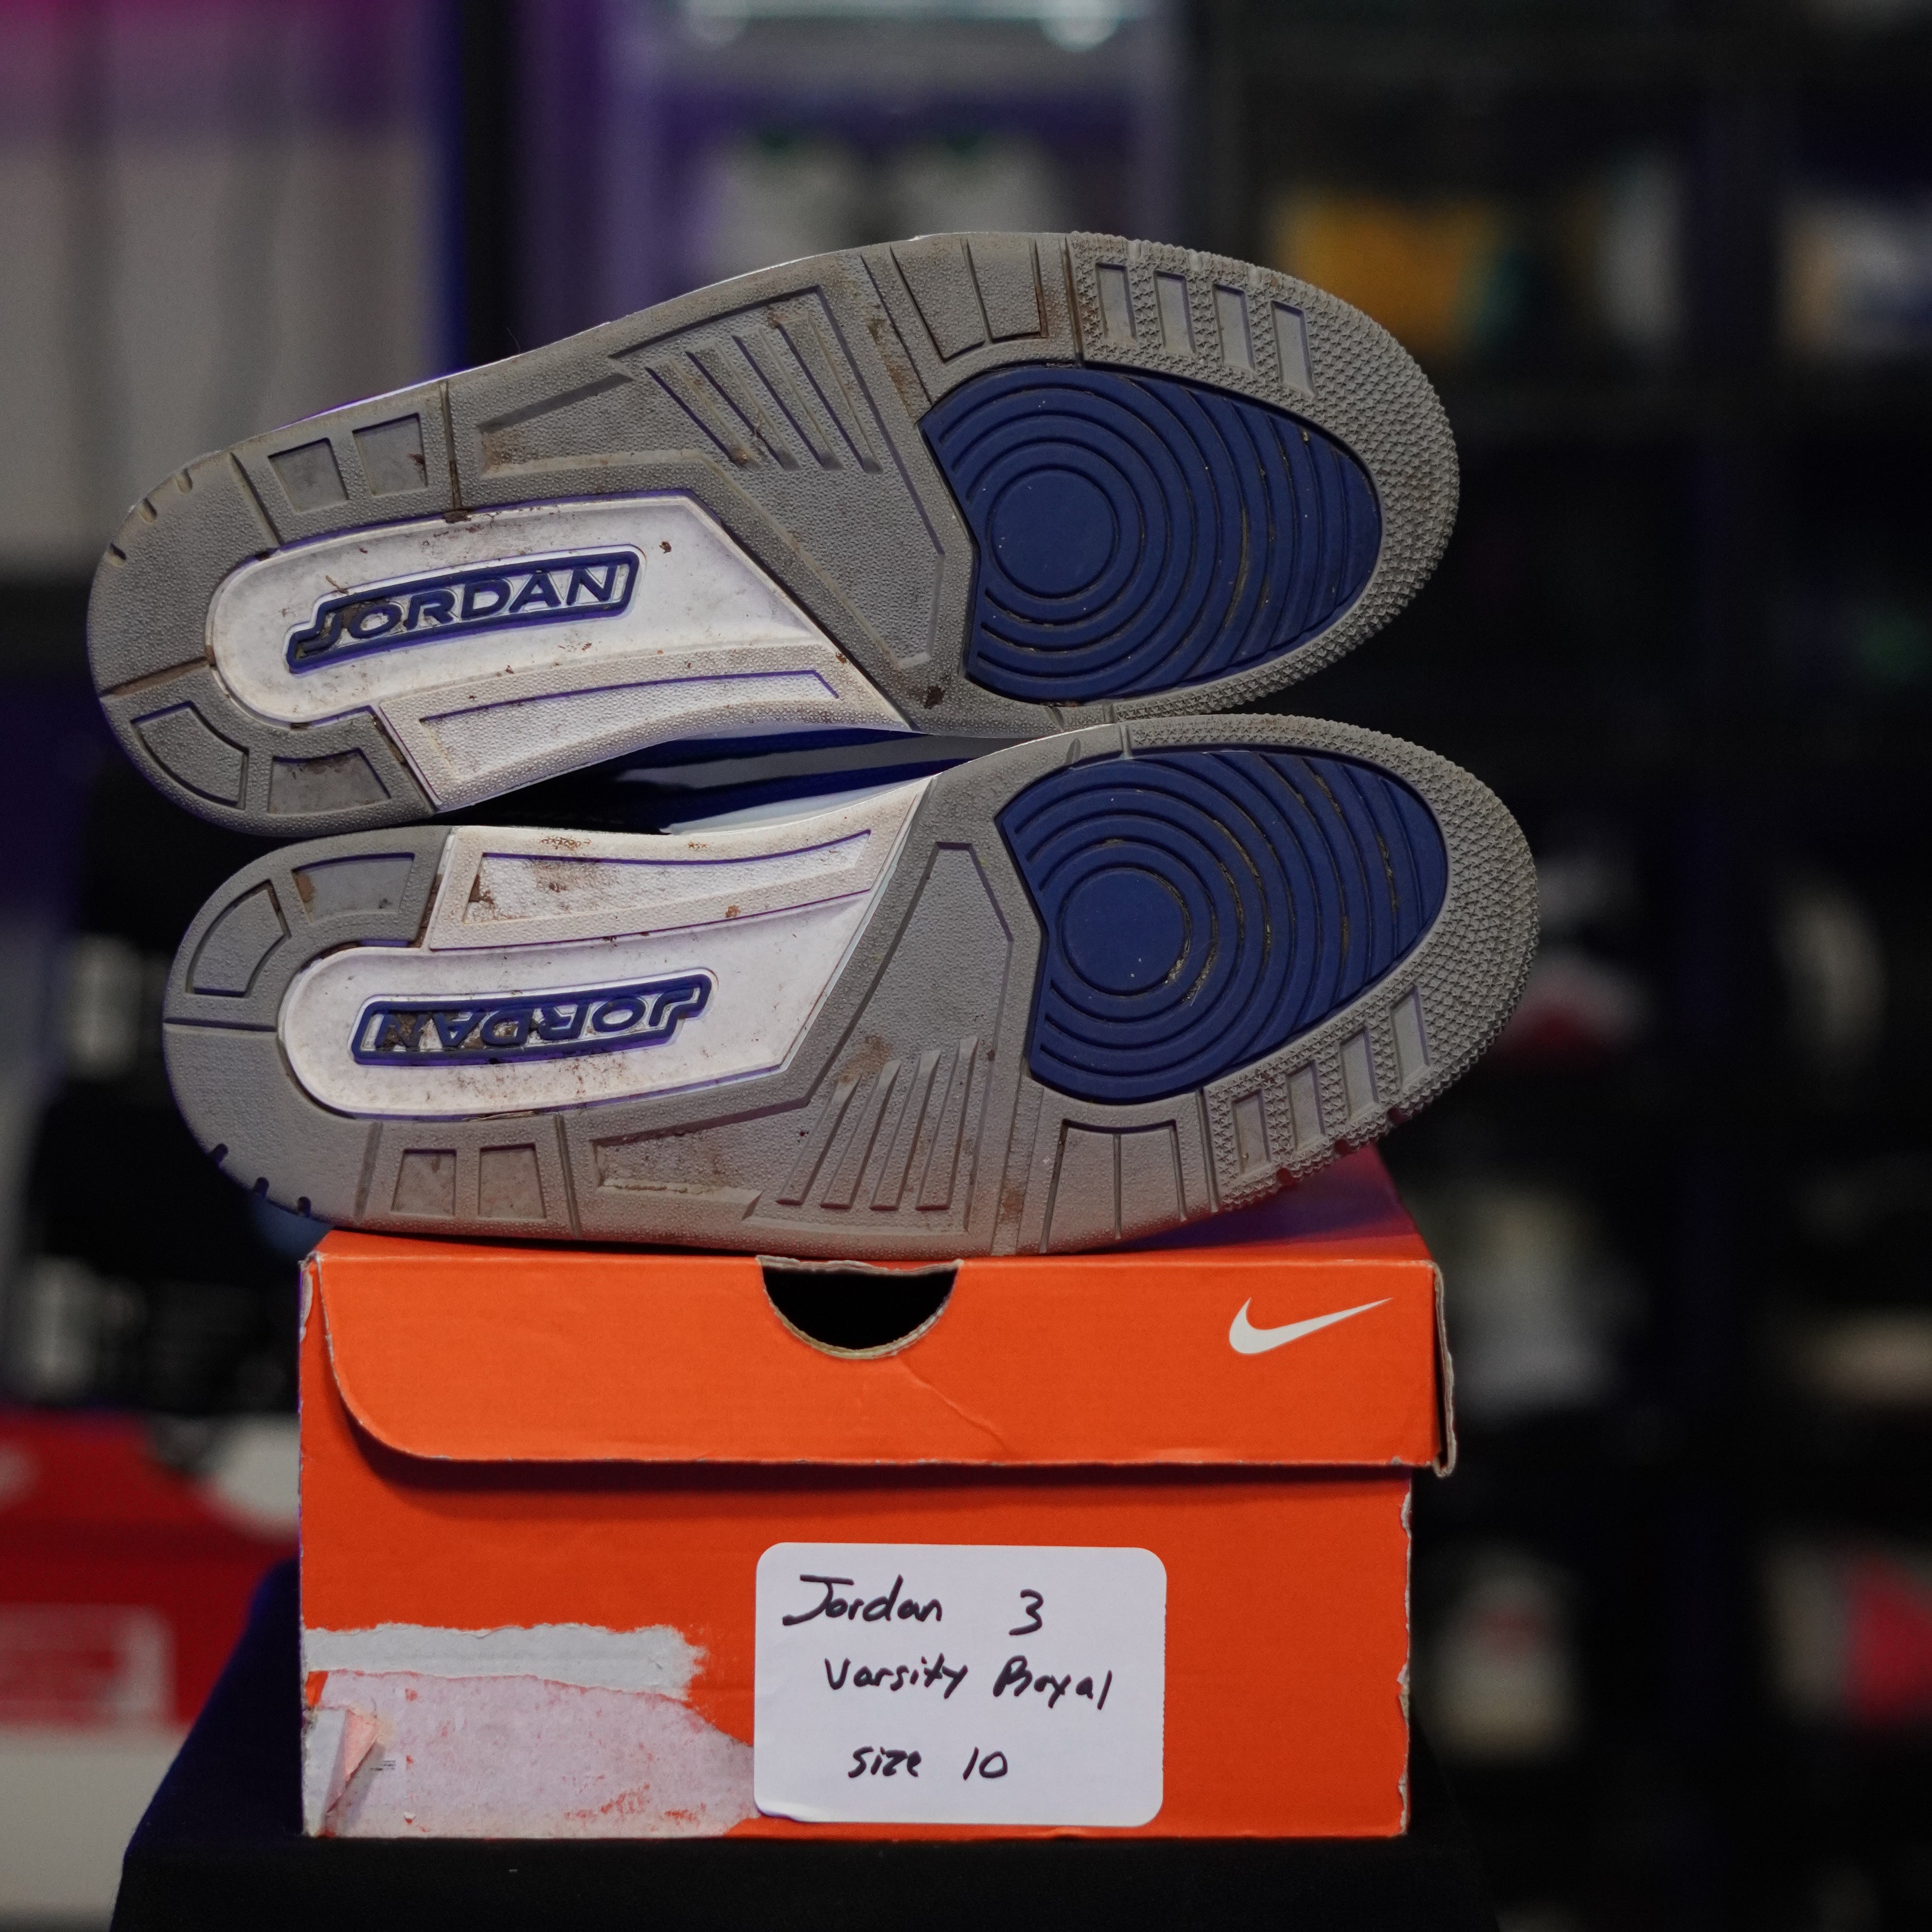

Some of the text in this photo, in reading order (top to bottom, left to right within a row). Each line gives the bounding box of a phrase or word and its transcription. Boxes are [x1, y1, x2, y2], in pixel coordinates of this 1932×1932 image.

[296, 566, 618, 654] JORDAN
[374, 986, 699, 1052] JORDAN
[782, 1574, 1044, 1636] Jordan 3
[824, 1652, 1113, 1711] Varsity Royal
[962, 1746, 1009, 1781] 10
